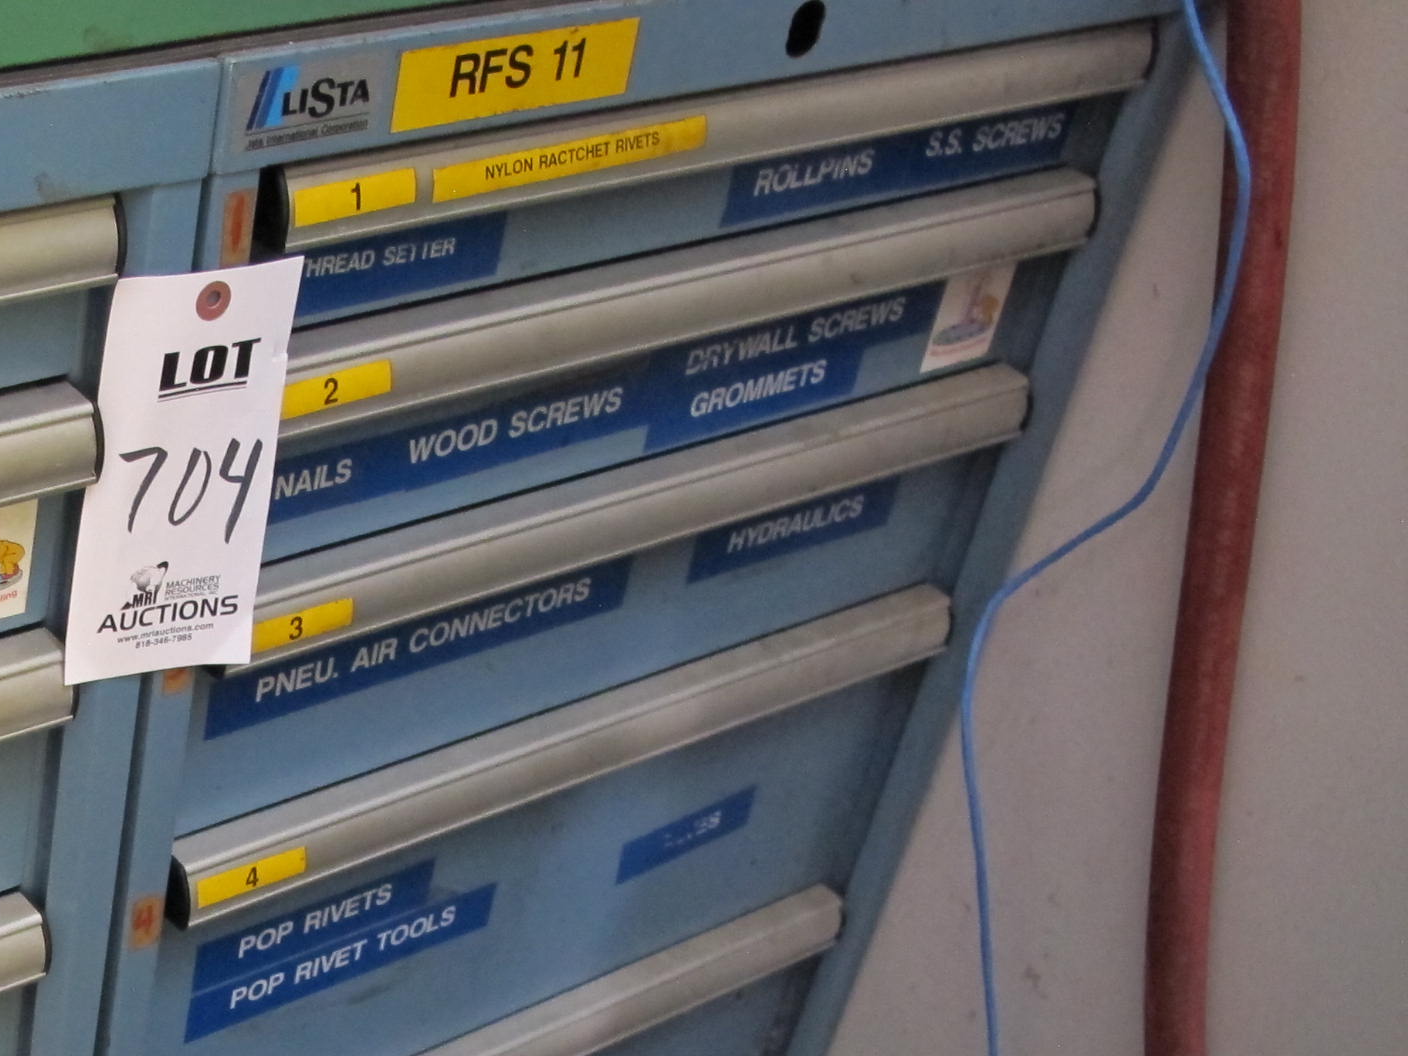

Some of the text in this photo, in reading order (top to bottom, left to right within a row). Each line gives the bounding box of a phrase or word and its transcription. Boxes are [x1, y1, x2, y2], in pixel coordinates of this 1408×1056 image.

[450, 38, 587, 99] RFS 11
[485, 131, 661, 181] NYLON RACTCHET RIVETS
[925, 113, 1067, 158] S.S. SCREWS
[351, 181, 361, 211] 1
[753, 149, 876, 197] ROLLPINS
[305, 249, 376, 278] HREAD
[685, 297, 906, 375] DRYWALL SCREWS
[159, 337, 261, 393] LOT
[323, 376, 340, 407] 2
[690, 359, 827, 418] GROMMETS
[409, 387, 623, 464] WOOD SCREWS
[119, 438, 262, 544] 704
[274, 458, 353, 500] NAILS
[728, 495, 864, 554] HYDRAULICS
[97, 594, 239, 633] AUCTIONS
[288, 615, 303, 641] 3
[256, 577, 590, 704] PNEU. AIR CONNECTORS
[246, 866, 259, 888] 4
[238, 883, 393, 959] POP RIVETS
[229, 905, 456, 1010] POP RIVET TOOLS
